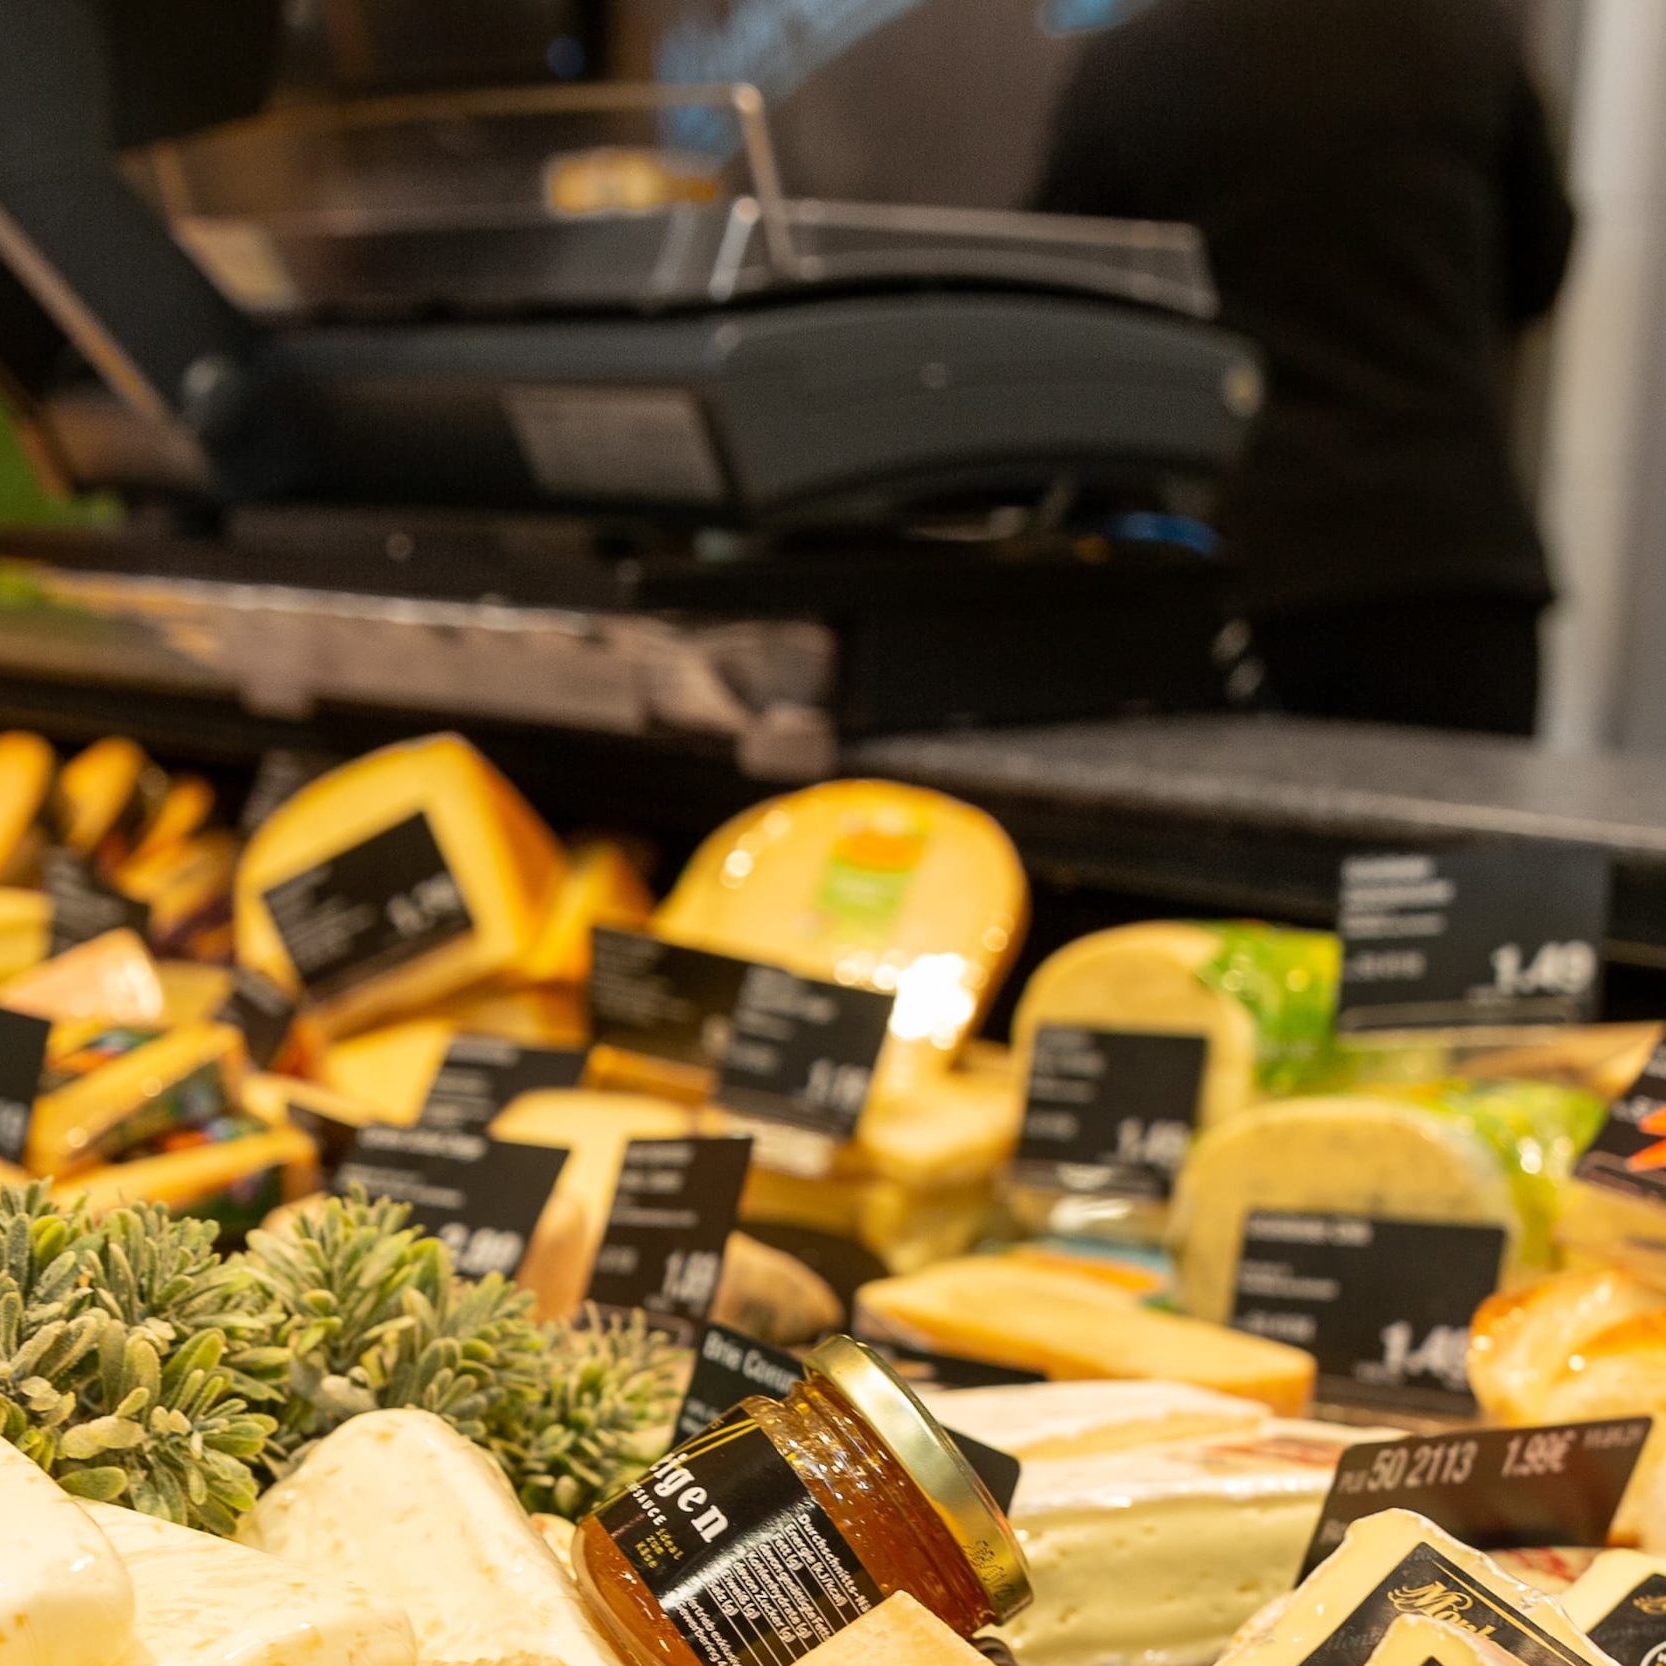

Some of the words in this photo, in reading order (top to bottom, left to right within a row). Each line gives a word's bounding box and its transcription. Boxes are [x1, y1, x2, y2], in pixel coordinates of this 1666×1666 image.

[1367, 1447, 1409, 1491] 50
[1404, 1440, 1479, 1488] 2113
[758, 1540, 783, 1573] davon
[778, 1572, 816, 1622] gesättigte
[769, 1530, 794, 1560] Fett
[782, 1521, 816, 1566] Energie
[810, 1562, 847, 1610] (kJ/kcal)
[731, 1562, 759, 1595] davon
[755, 1591, 785, 1632] Zucker
[744, 1548, 800, 1629] Kohlenhydrate
